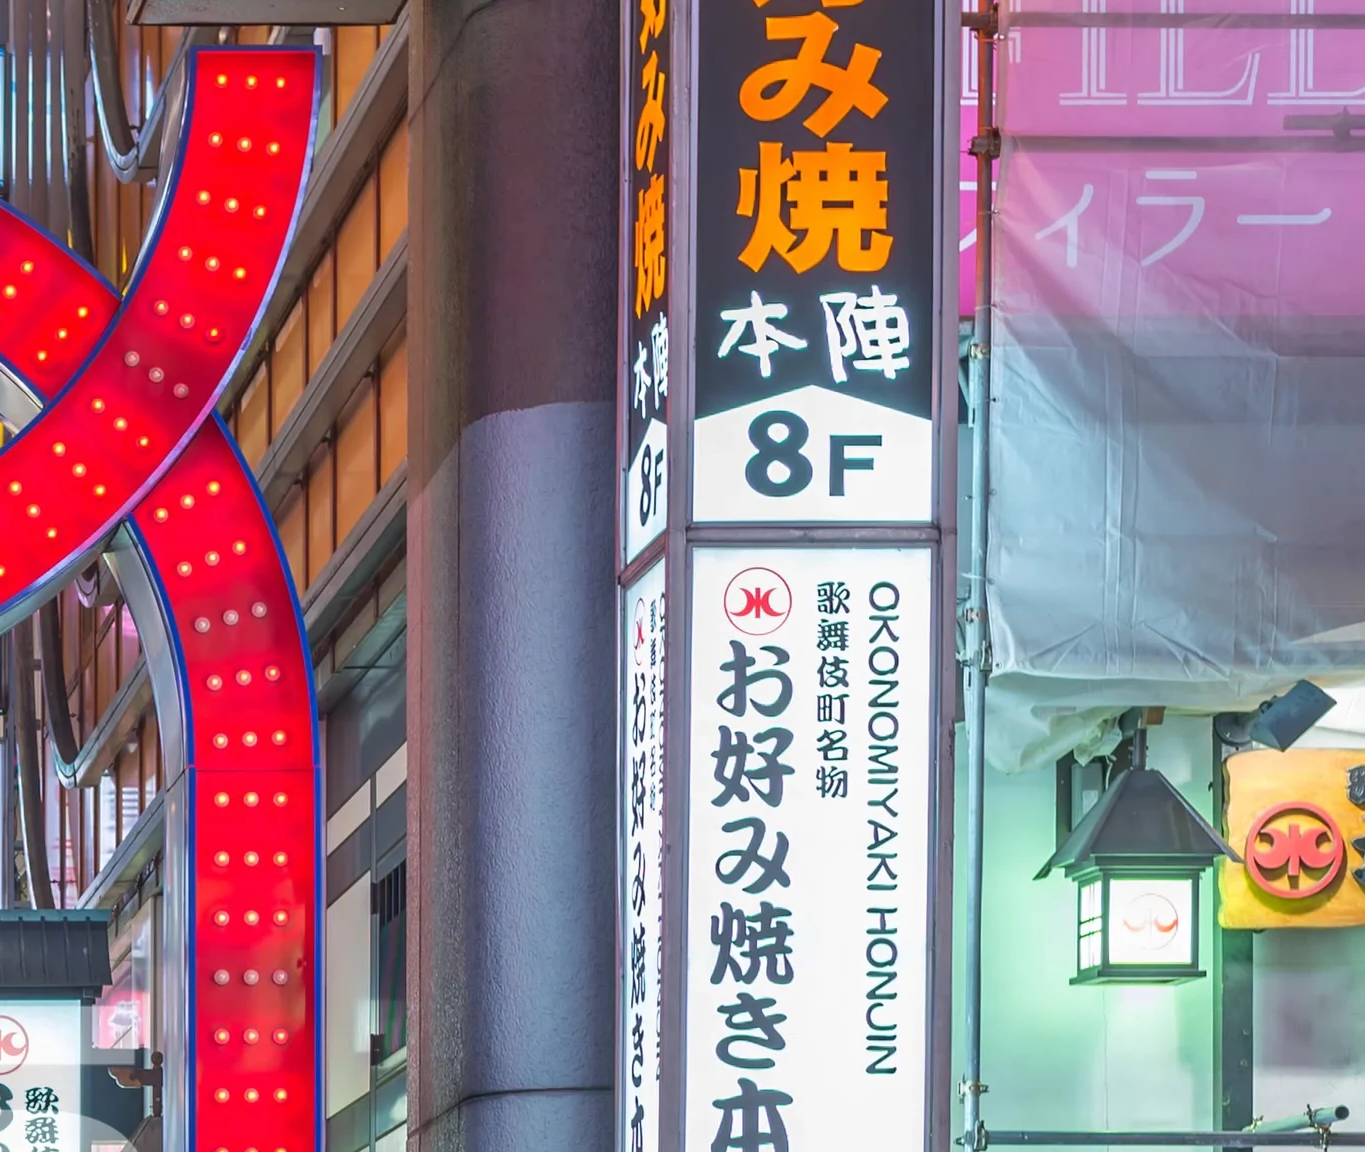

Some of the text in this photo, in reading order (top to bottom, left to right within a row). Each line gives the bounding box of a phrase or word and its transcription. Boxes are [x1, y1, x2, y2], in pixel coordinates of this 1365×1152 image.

[738, 0, 894, 274] み焼
[719, 287, 911, 383] 本陣
[638, 443, 664, 527] 8F
[744, 410, 883, 499] 8F
[815, 581, 851, 799] 歌舞伎町名物
[866, 581, 900, 1074] OKONOMIYAKI HONJIN
